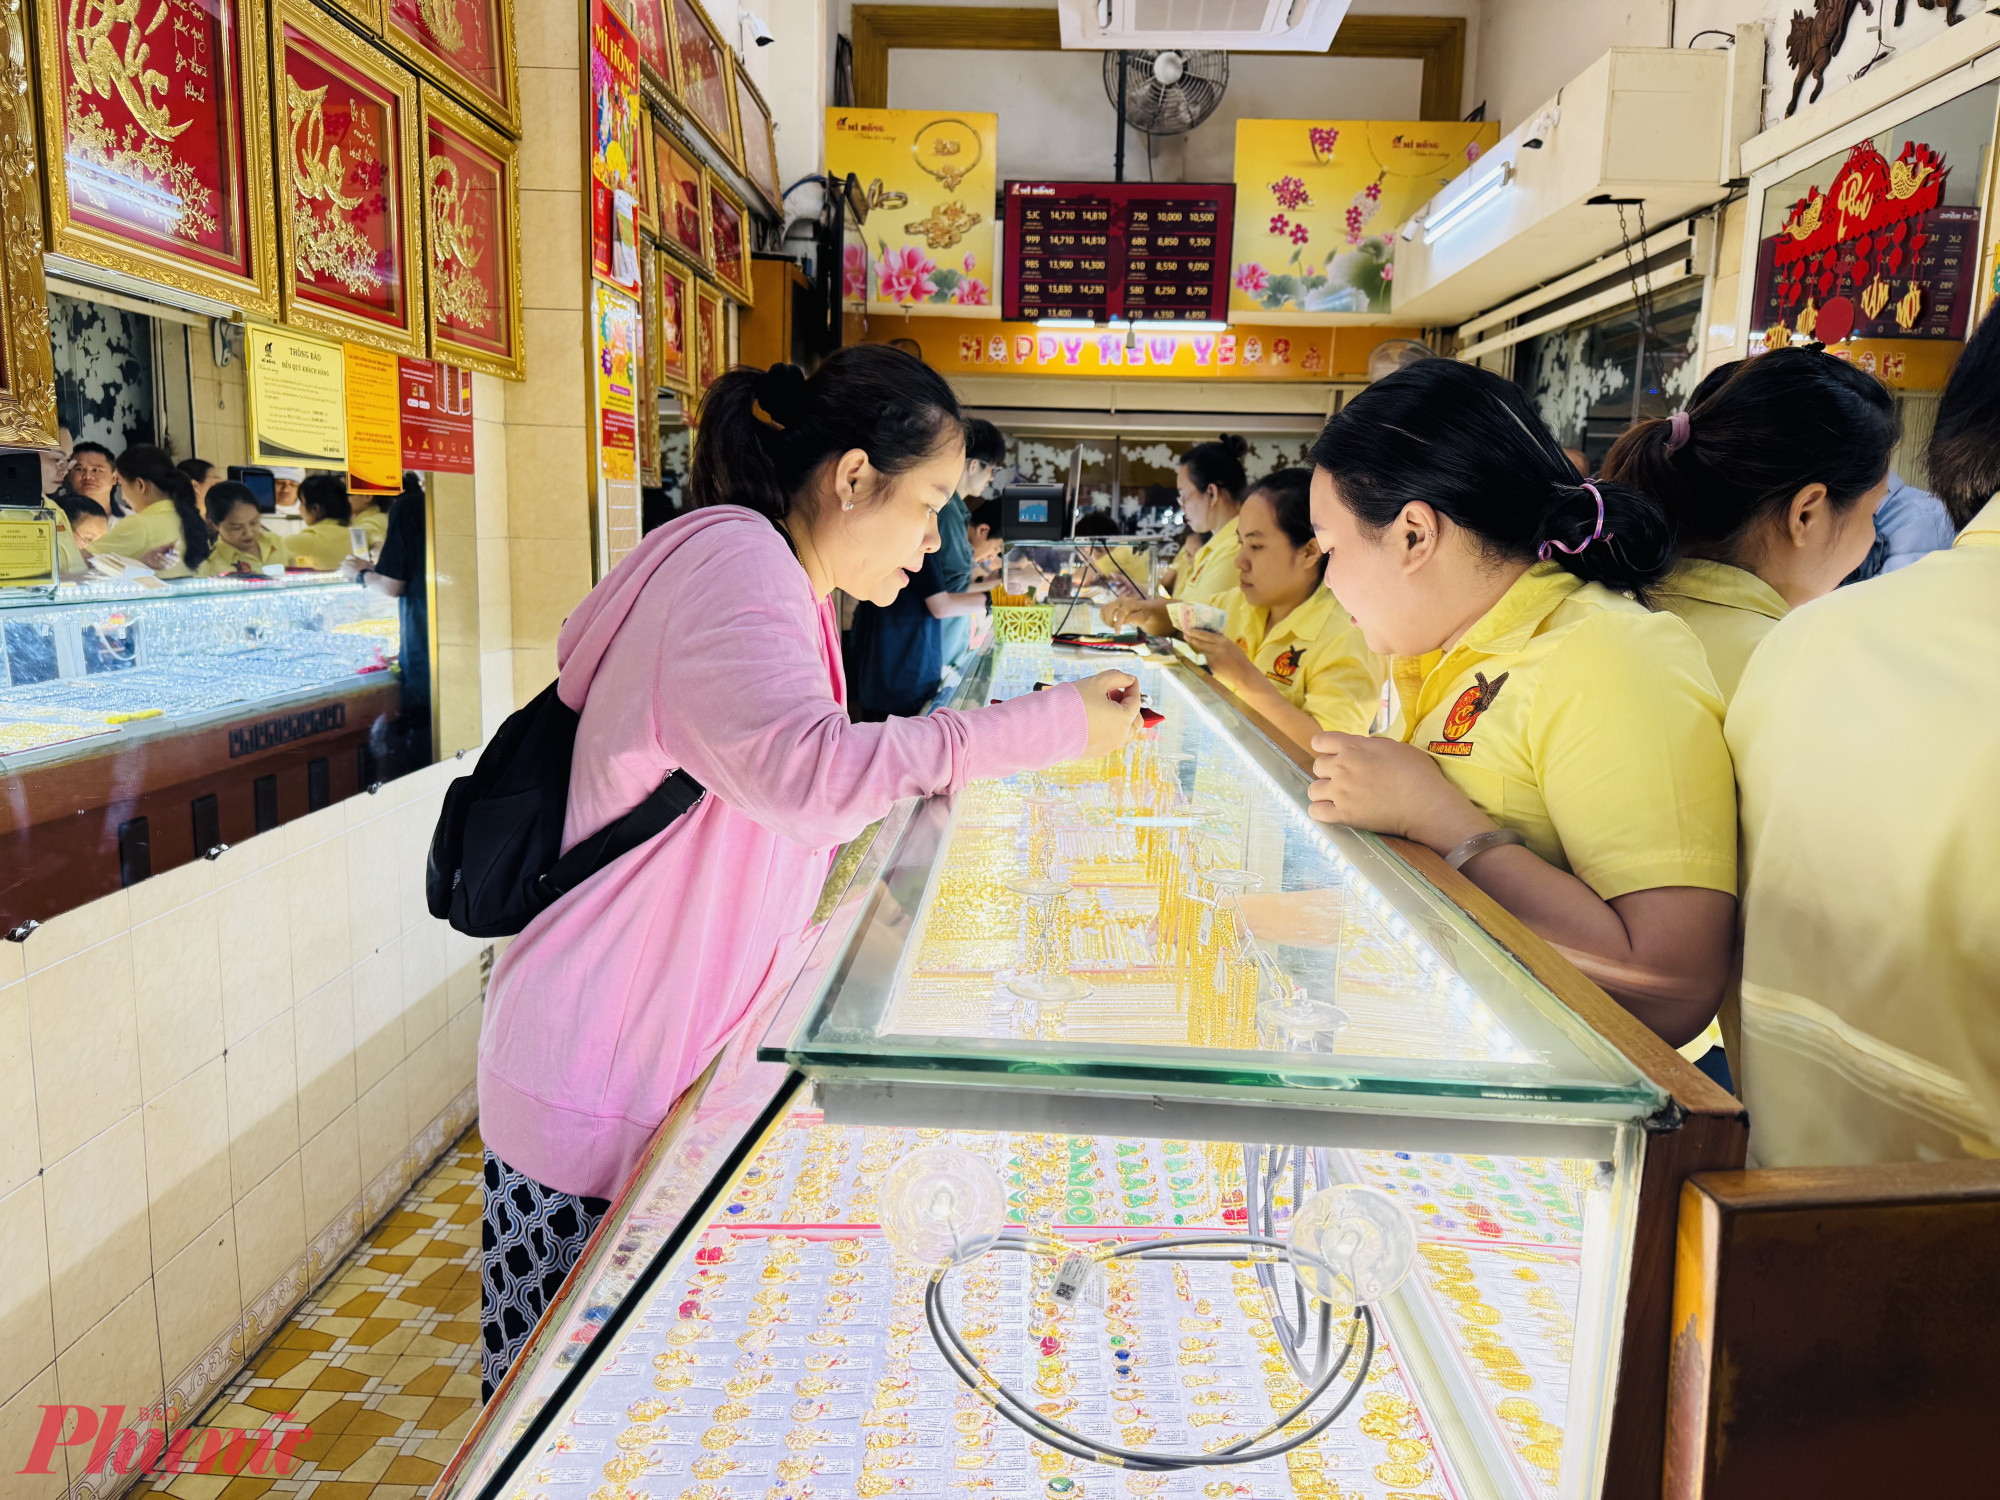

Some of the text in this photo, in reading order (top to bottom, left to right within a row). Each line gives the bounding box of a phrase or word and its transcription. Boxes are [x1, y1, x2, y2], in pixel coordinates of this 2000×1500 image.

[1026, 210, 1107, 221] SJC 14,710 14,810
[1133, 212, 1148, 221] 750
[1189, 212, 1215, 223] 10,500
[1025, 235, 1106, 246] 999 14,710 14,810
[1131, 237, 1147, 246] 680
[1025, 260, 1039, 269] 985
[959, 333, 1292, 366] HAPPY NEW YEAR
